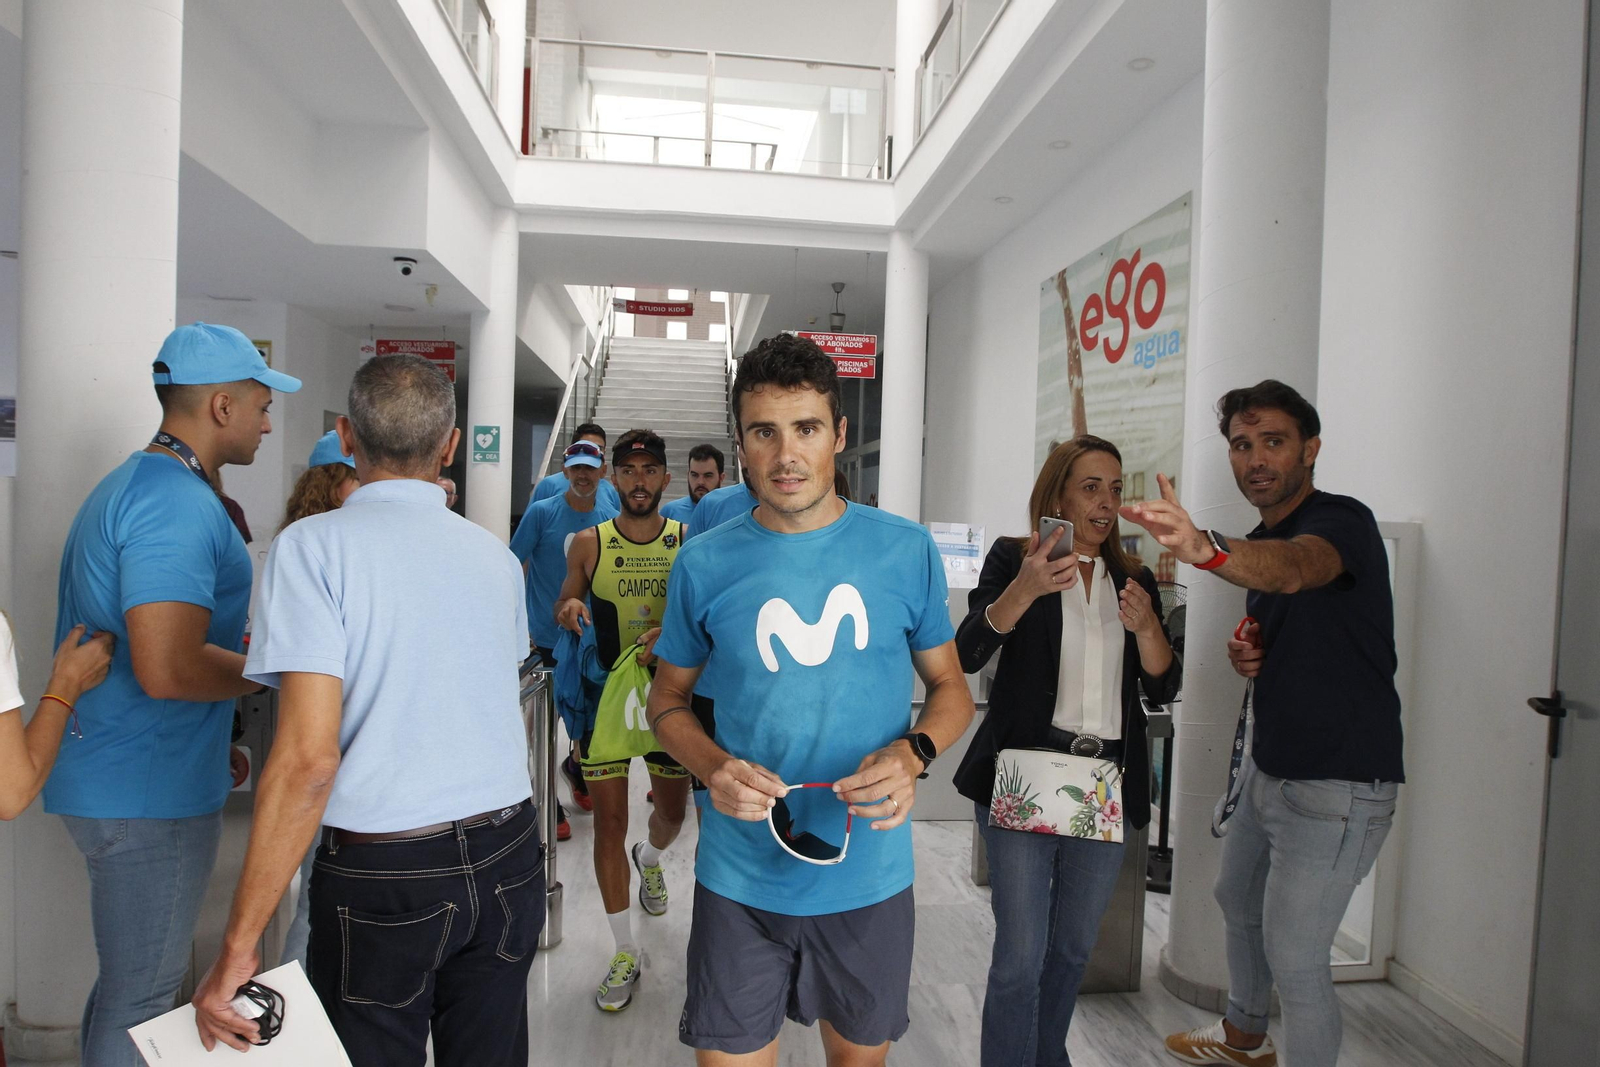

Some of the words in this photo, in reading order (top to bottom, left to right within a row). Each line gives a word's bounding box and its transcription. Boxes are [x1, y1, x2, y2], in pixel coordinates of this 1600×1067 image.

[1079, 247, 1167, 364] ego
[1133, 329, 1180, 369] agua
[618, 578, 668, 598] CAMPOS
